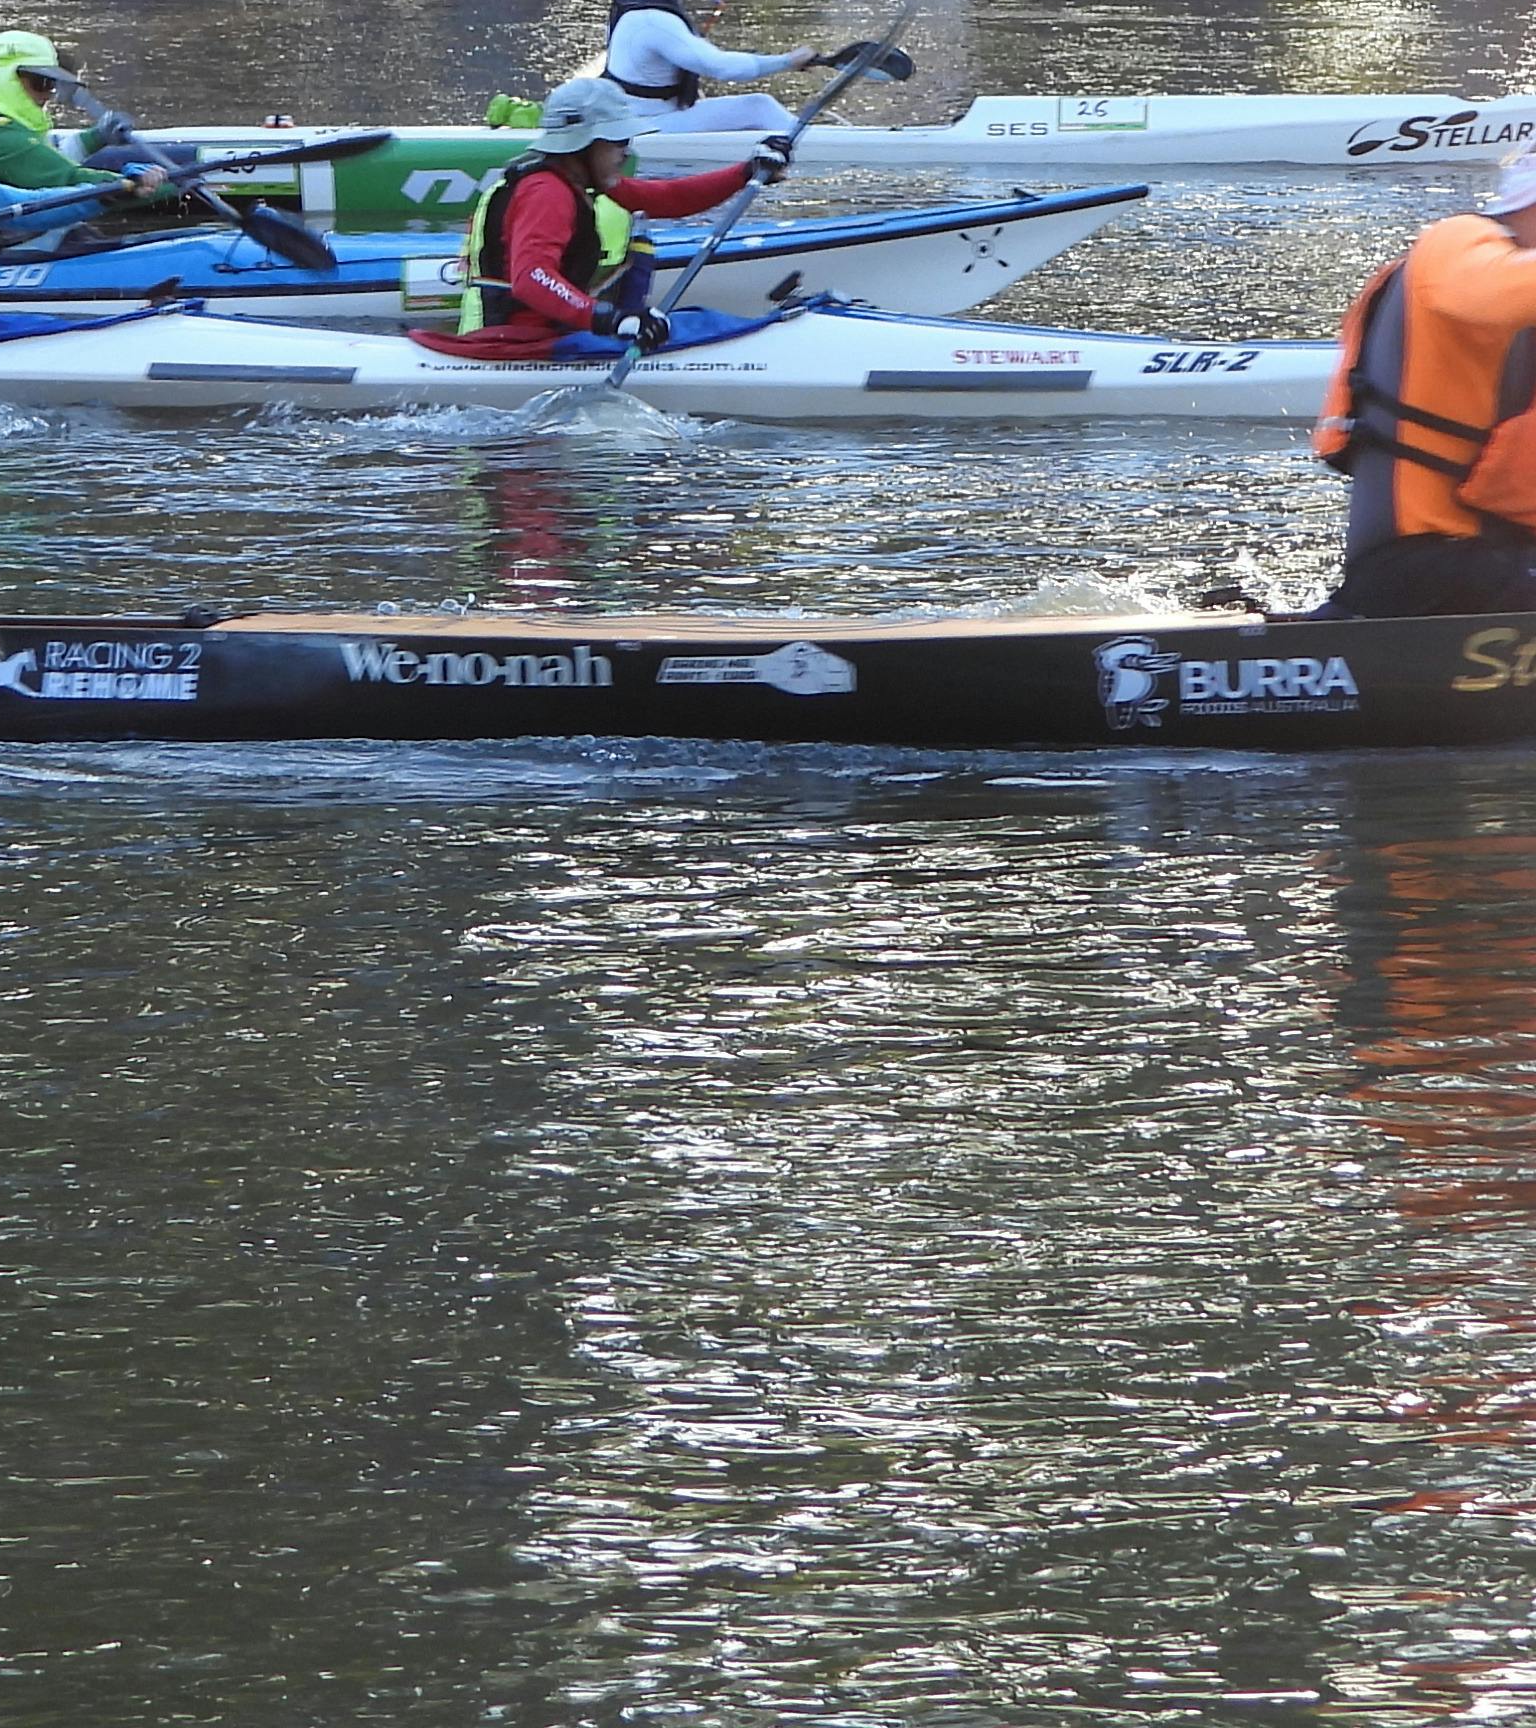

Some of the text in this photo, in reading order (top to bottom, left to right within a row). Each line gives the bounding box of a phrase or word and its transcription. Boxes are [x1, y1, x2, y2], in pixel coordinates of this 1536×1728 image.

[1077, 99, 1109, 117] 26
[987, 122, 1048, 136] SES
[1389, 115, 1534, 152] STELLAR
[952, 349, 1084, 365] STEWART
[1139, 350, 1263, 373] SLR-2
[44, 641, 202, 669] RACING 2
[41, 671, 200, 699] REHOME
[1179, 656, 1359, 700] BURRA
